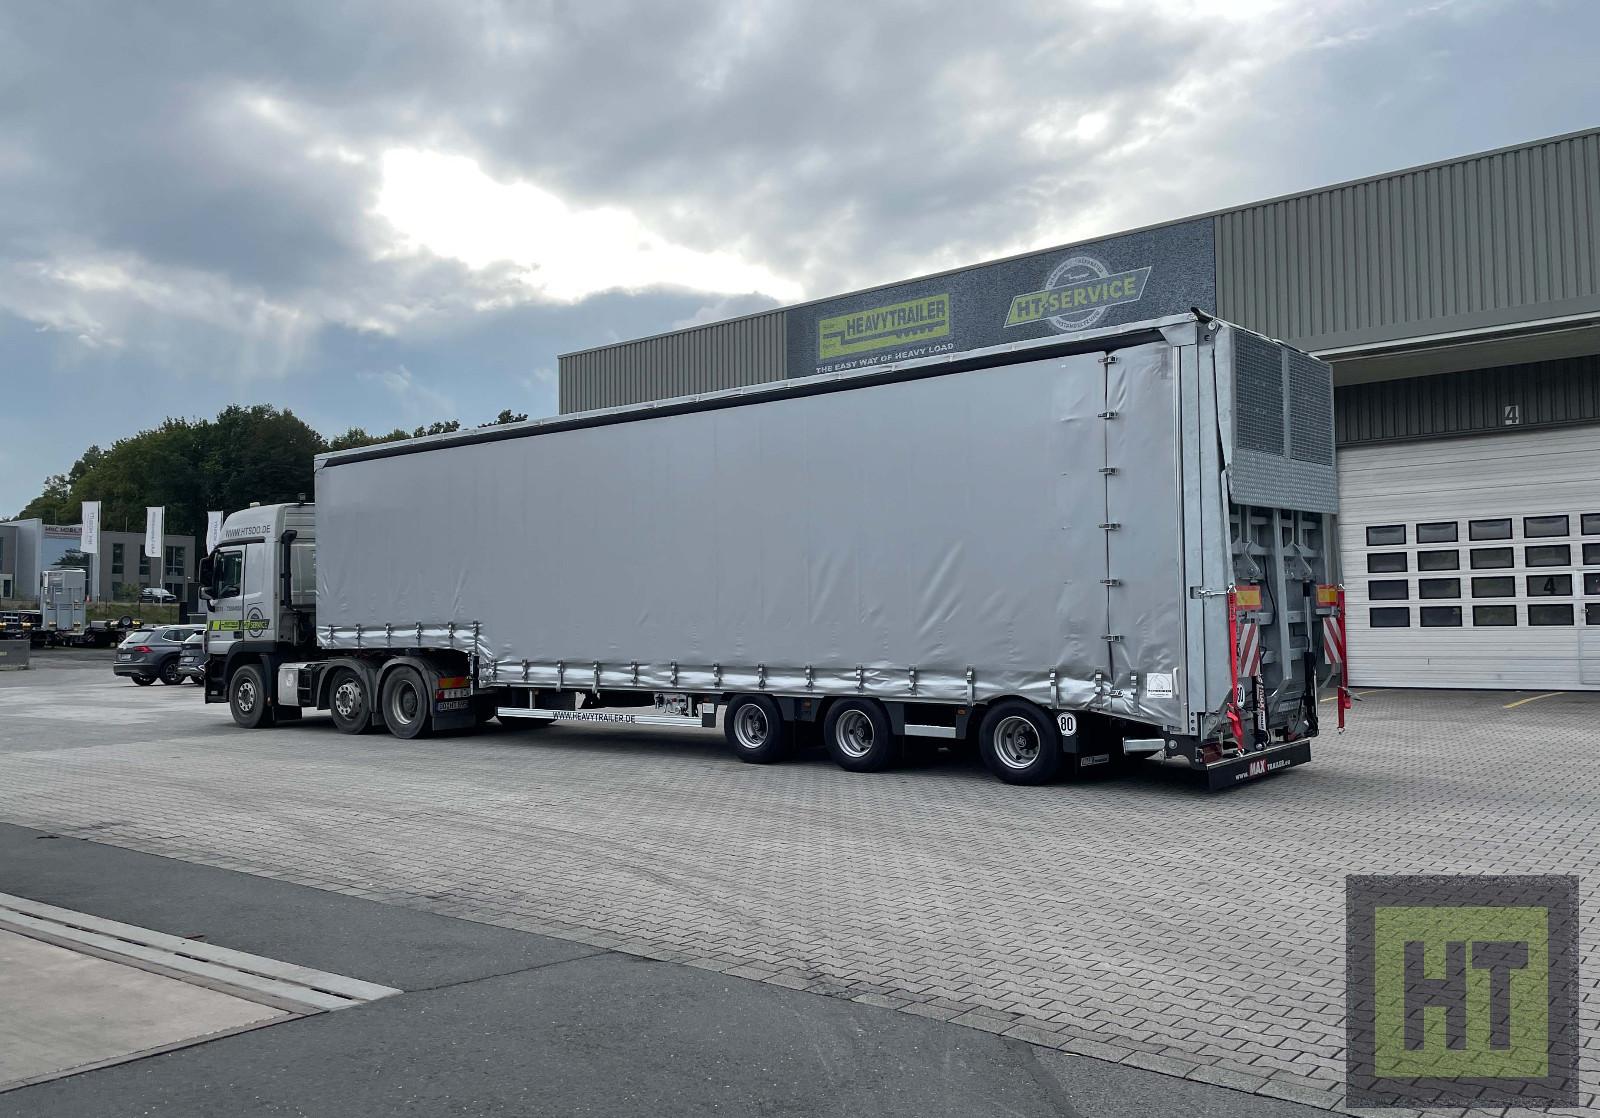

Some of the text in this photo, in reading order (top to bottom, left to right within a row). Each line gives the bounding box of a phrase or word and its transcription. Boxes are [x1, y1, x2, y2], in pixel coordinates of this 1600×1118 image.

[1016, 276, 1137, 319] HT-SERVICE
[846, 299, 946, 336] HEAVYTRAILER
[816, 342, 954, 374] THE EASY WAY OF HEAVY LOAD
[1504, 406, 1519, 425] 4
[1543, 577, 1556, 594] 4
[552, 711, 636, 722] WWW.HEAVYTRAILER.DE
[1060, 716, 1073, 731] 80
[1249, 760, 1265, 776] MAX
